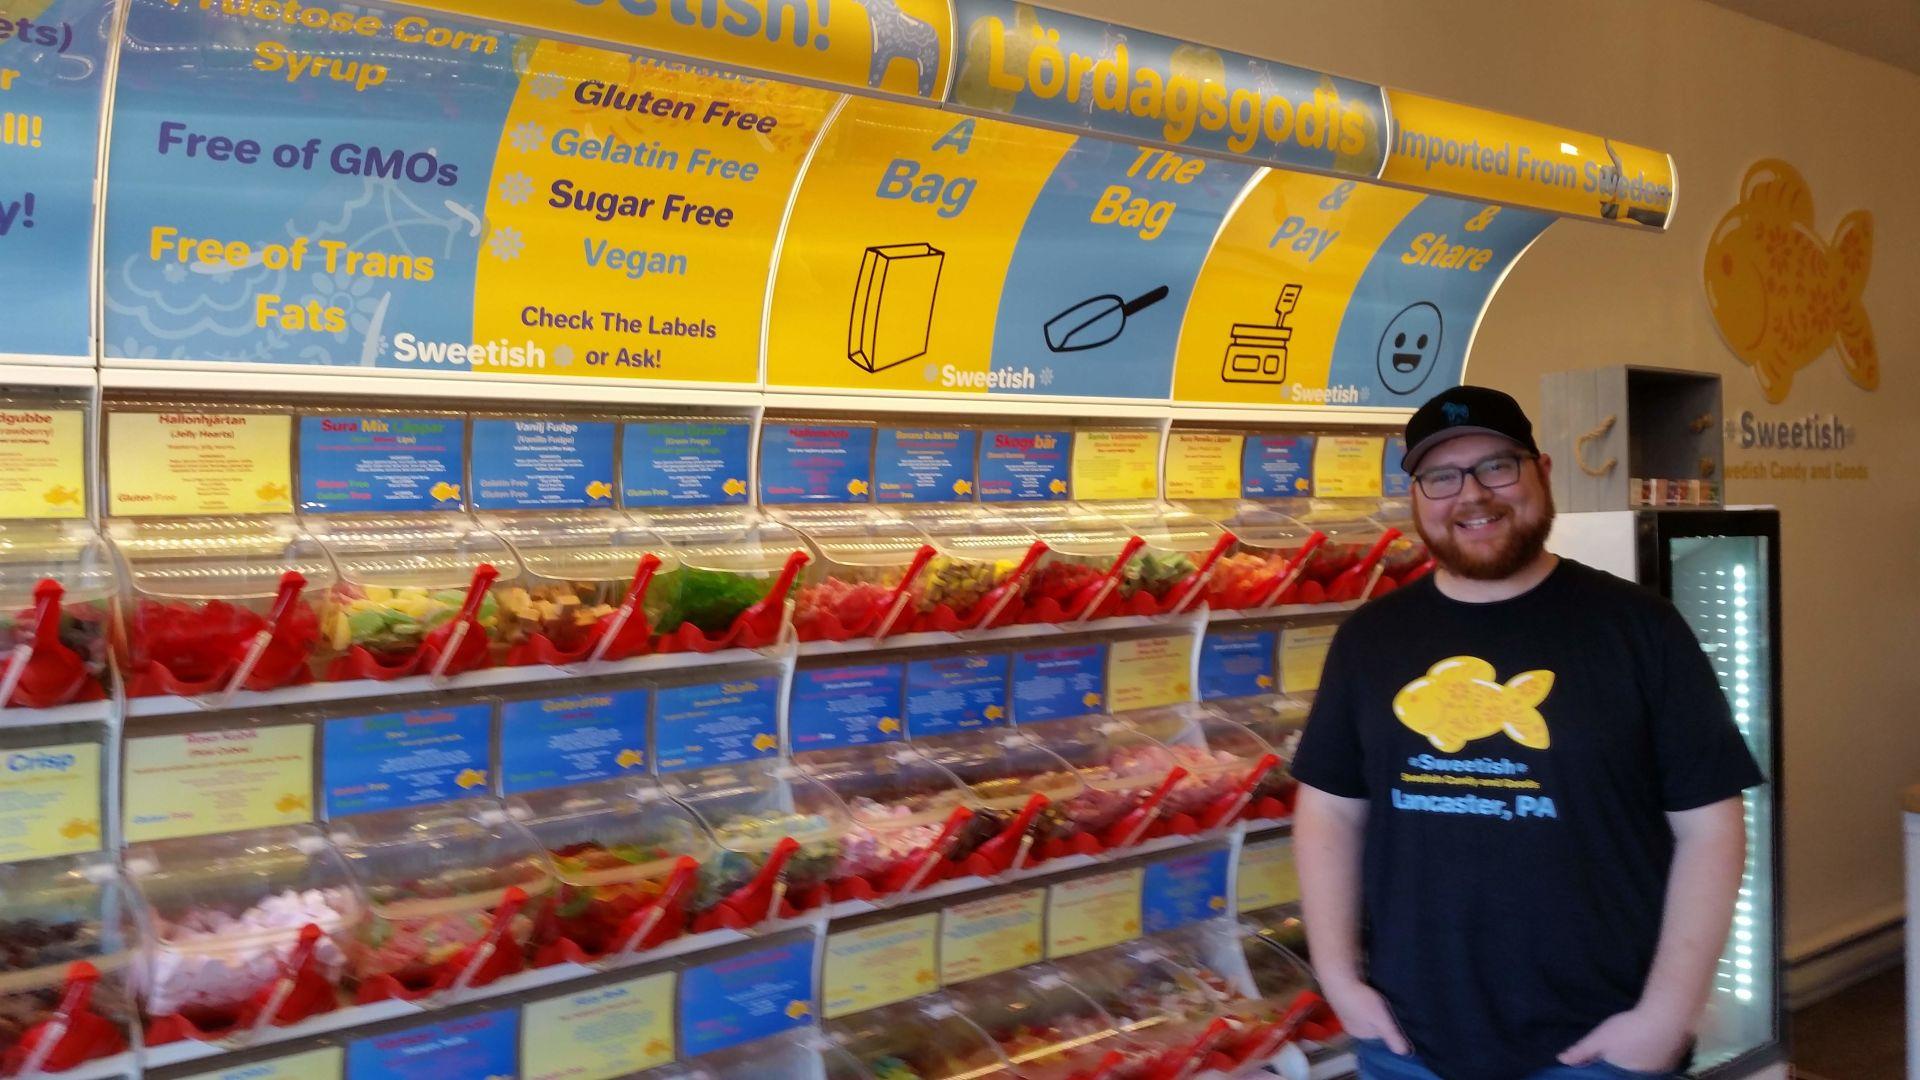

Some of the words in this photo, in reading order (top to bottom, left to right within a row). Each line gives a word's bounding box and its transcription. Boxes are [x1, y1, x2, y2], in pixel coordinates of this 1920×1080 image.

[166, 0, 384, 37] uctose
[395, 16, 498, 55] Corn
[253, 41, 388, 91] Syrup
[986, 16, 1367, 156] Lördagsgodis
[573, 79, 696, 121] Gluten
[701, 99, 778, 134] Free
[0, 112, 42, 147] ll!
[931, 118, 977, 154] A
[157, 120, 261, 165] Free
[272, 138, 321, 171] of
[330, 143, 459, 187] GMOs
[550, 128, 678, 171] Gelatin
[686, 148, 760, 182] Free
[1126, 145, 1205, 186] The
[1391, 119, 1510, 176] Imported
[1517, 146, 1577, 188] From
[548, 179, 655, 221] Sugar
[662, 194, 734, 228] Free
[876, 158, 978, 219] Bag
[1090, 184, 1177, 241] Bag
[149, 225, 251, 266] Free
[262, 237, 308, 271] of
[318, 239, 435, 282] Trans
[583, 237, 687, 280] Vegan
[1268, 215, 1342, 262] Pay
[1400, 231, 1493, 272] Share
[255, 294, 347, 333] Fats
[520, 305, 594, 331] Check
[601, 311, 643, 335] The
[648, 315, 717, 340] Labels
[393, 332, 546, 369] Sweetish
[585, 349, 610, 368] or
[615, 348, 662, 369] Ask!
[941, 365, 1035, 390] Sweetish
[1291, 383, 1359, 404] Sweetish
[1741, 410, 1845, 449] Sweetish
[1724, 460, 1767, 480] wedish
[1770, 461, 1807, 482] Candy
[1810, 463, 1831, 480] and
[1515, 795, 1558, 818] PA
